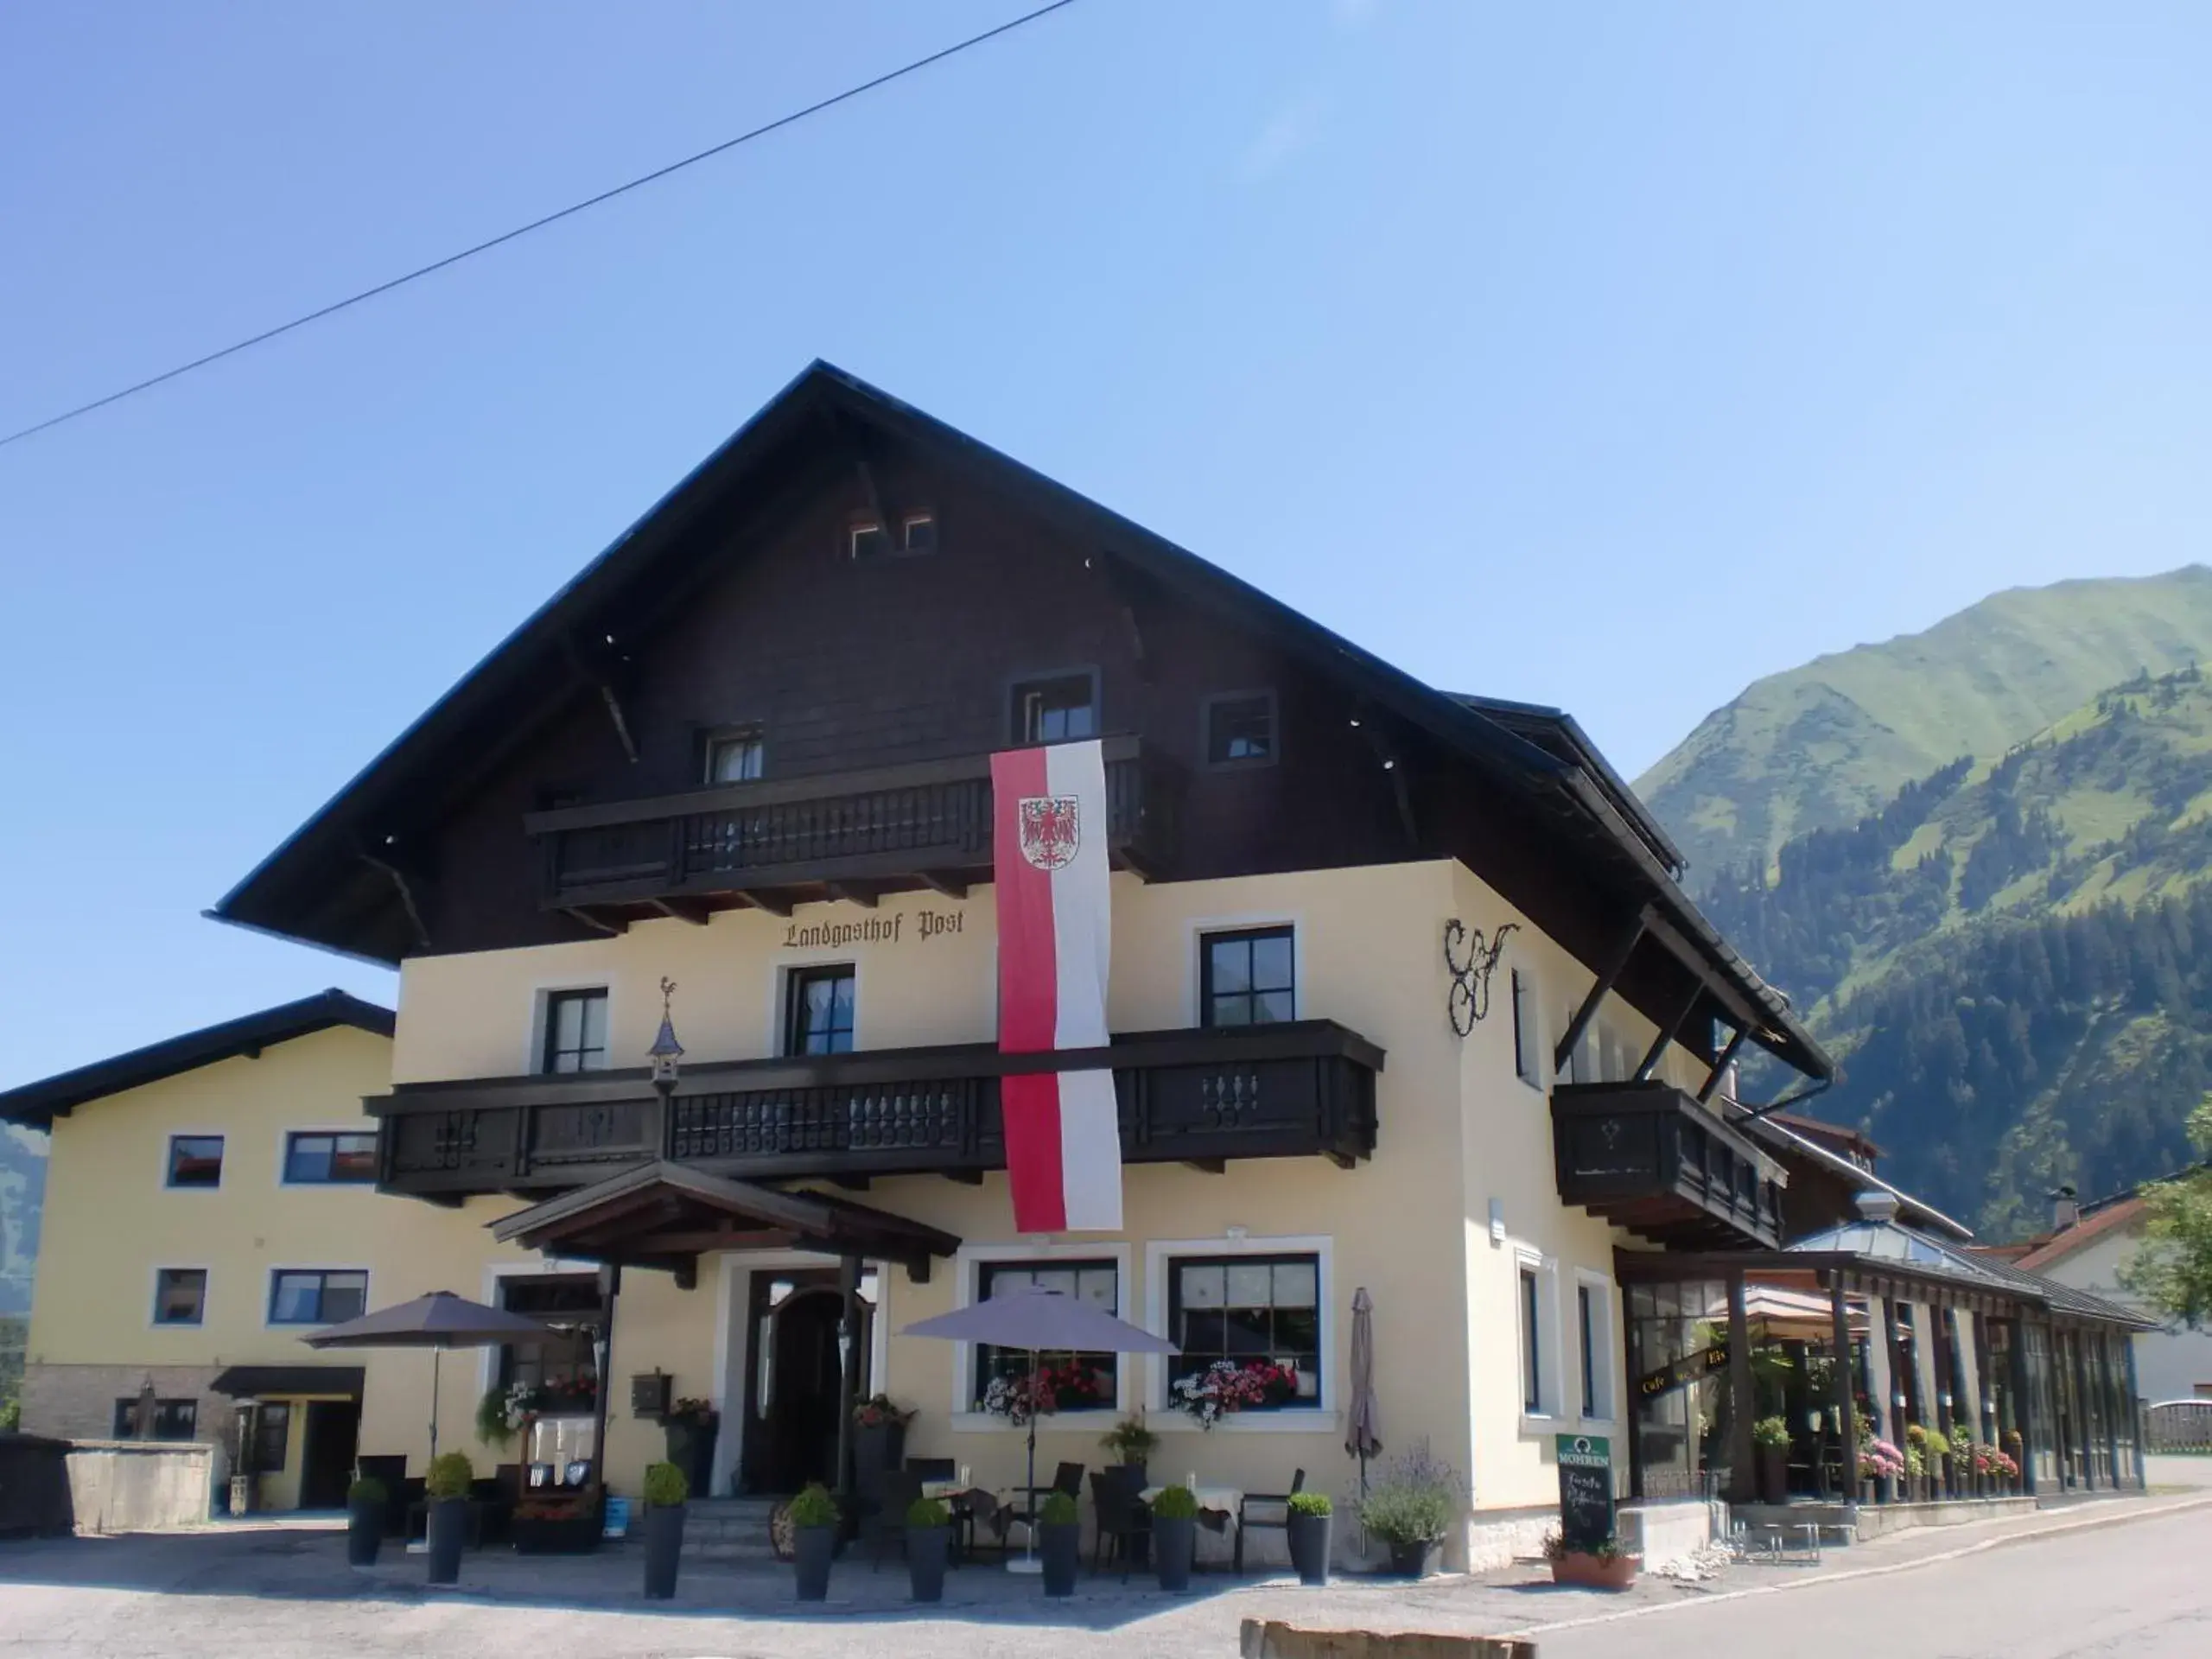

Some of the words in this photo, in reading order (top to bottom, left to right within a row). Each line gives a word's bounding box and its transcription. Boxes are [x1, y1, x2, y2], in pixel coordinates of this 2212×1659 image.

[782, 913, 904, 948] Landgasthof
[918, 910, 964, 941] Post
[1559, 1452, 1609, 1466] MOHREN
